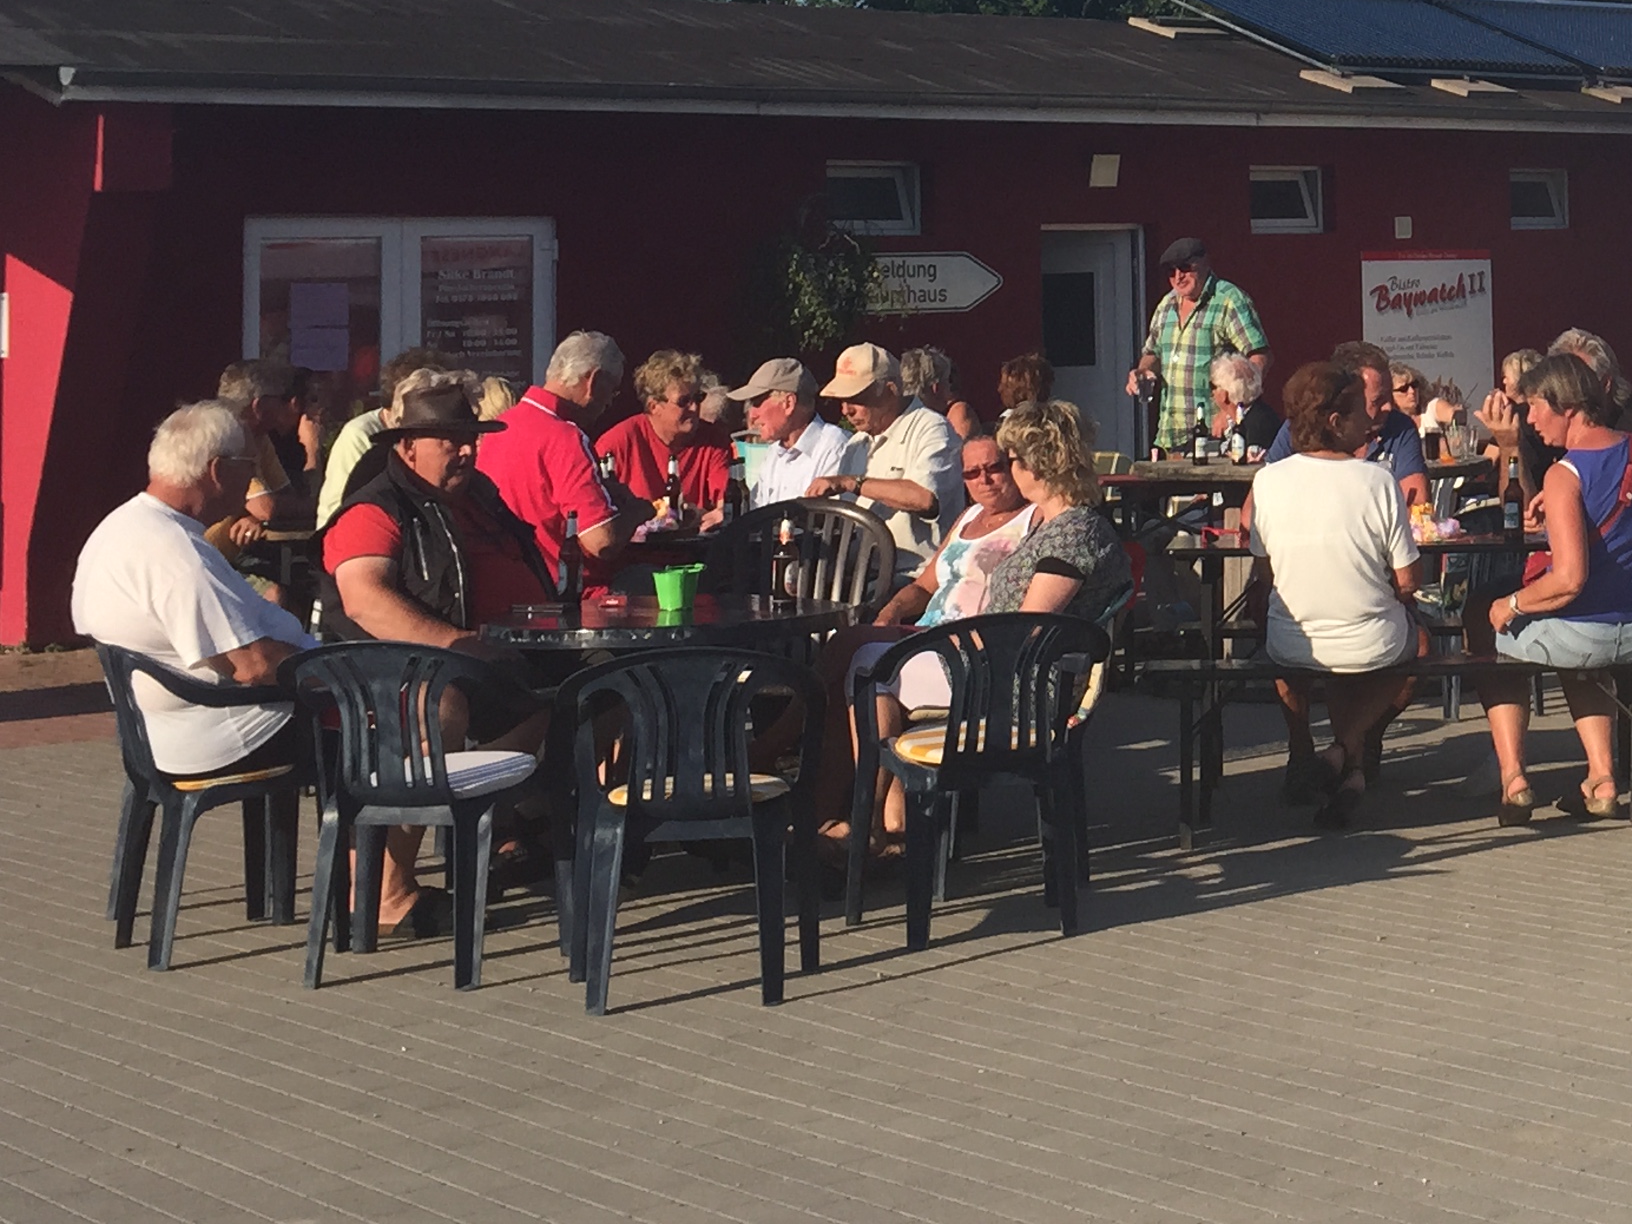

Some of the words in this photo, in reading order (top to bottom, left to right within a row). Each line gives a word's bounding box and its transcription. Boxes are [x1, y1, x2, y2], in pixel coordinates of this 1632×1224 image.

[881, 260, 938, 283] eldung
[1369, 272, 1466, 317] Baywatch
[1467, 270, 1486, 295] II
[1387, 275, 1421, 292] Bistro
